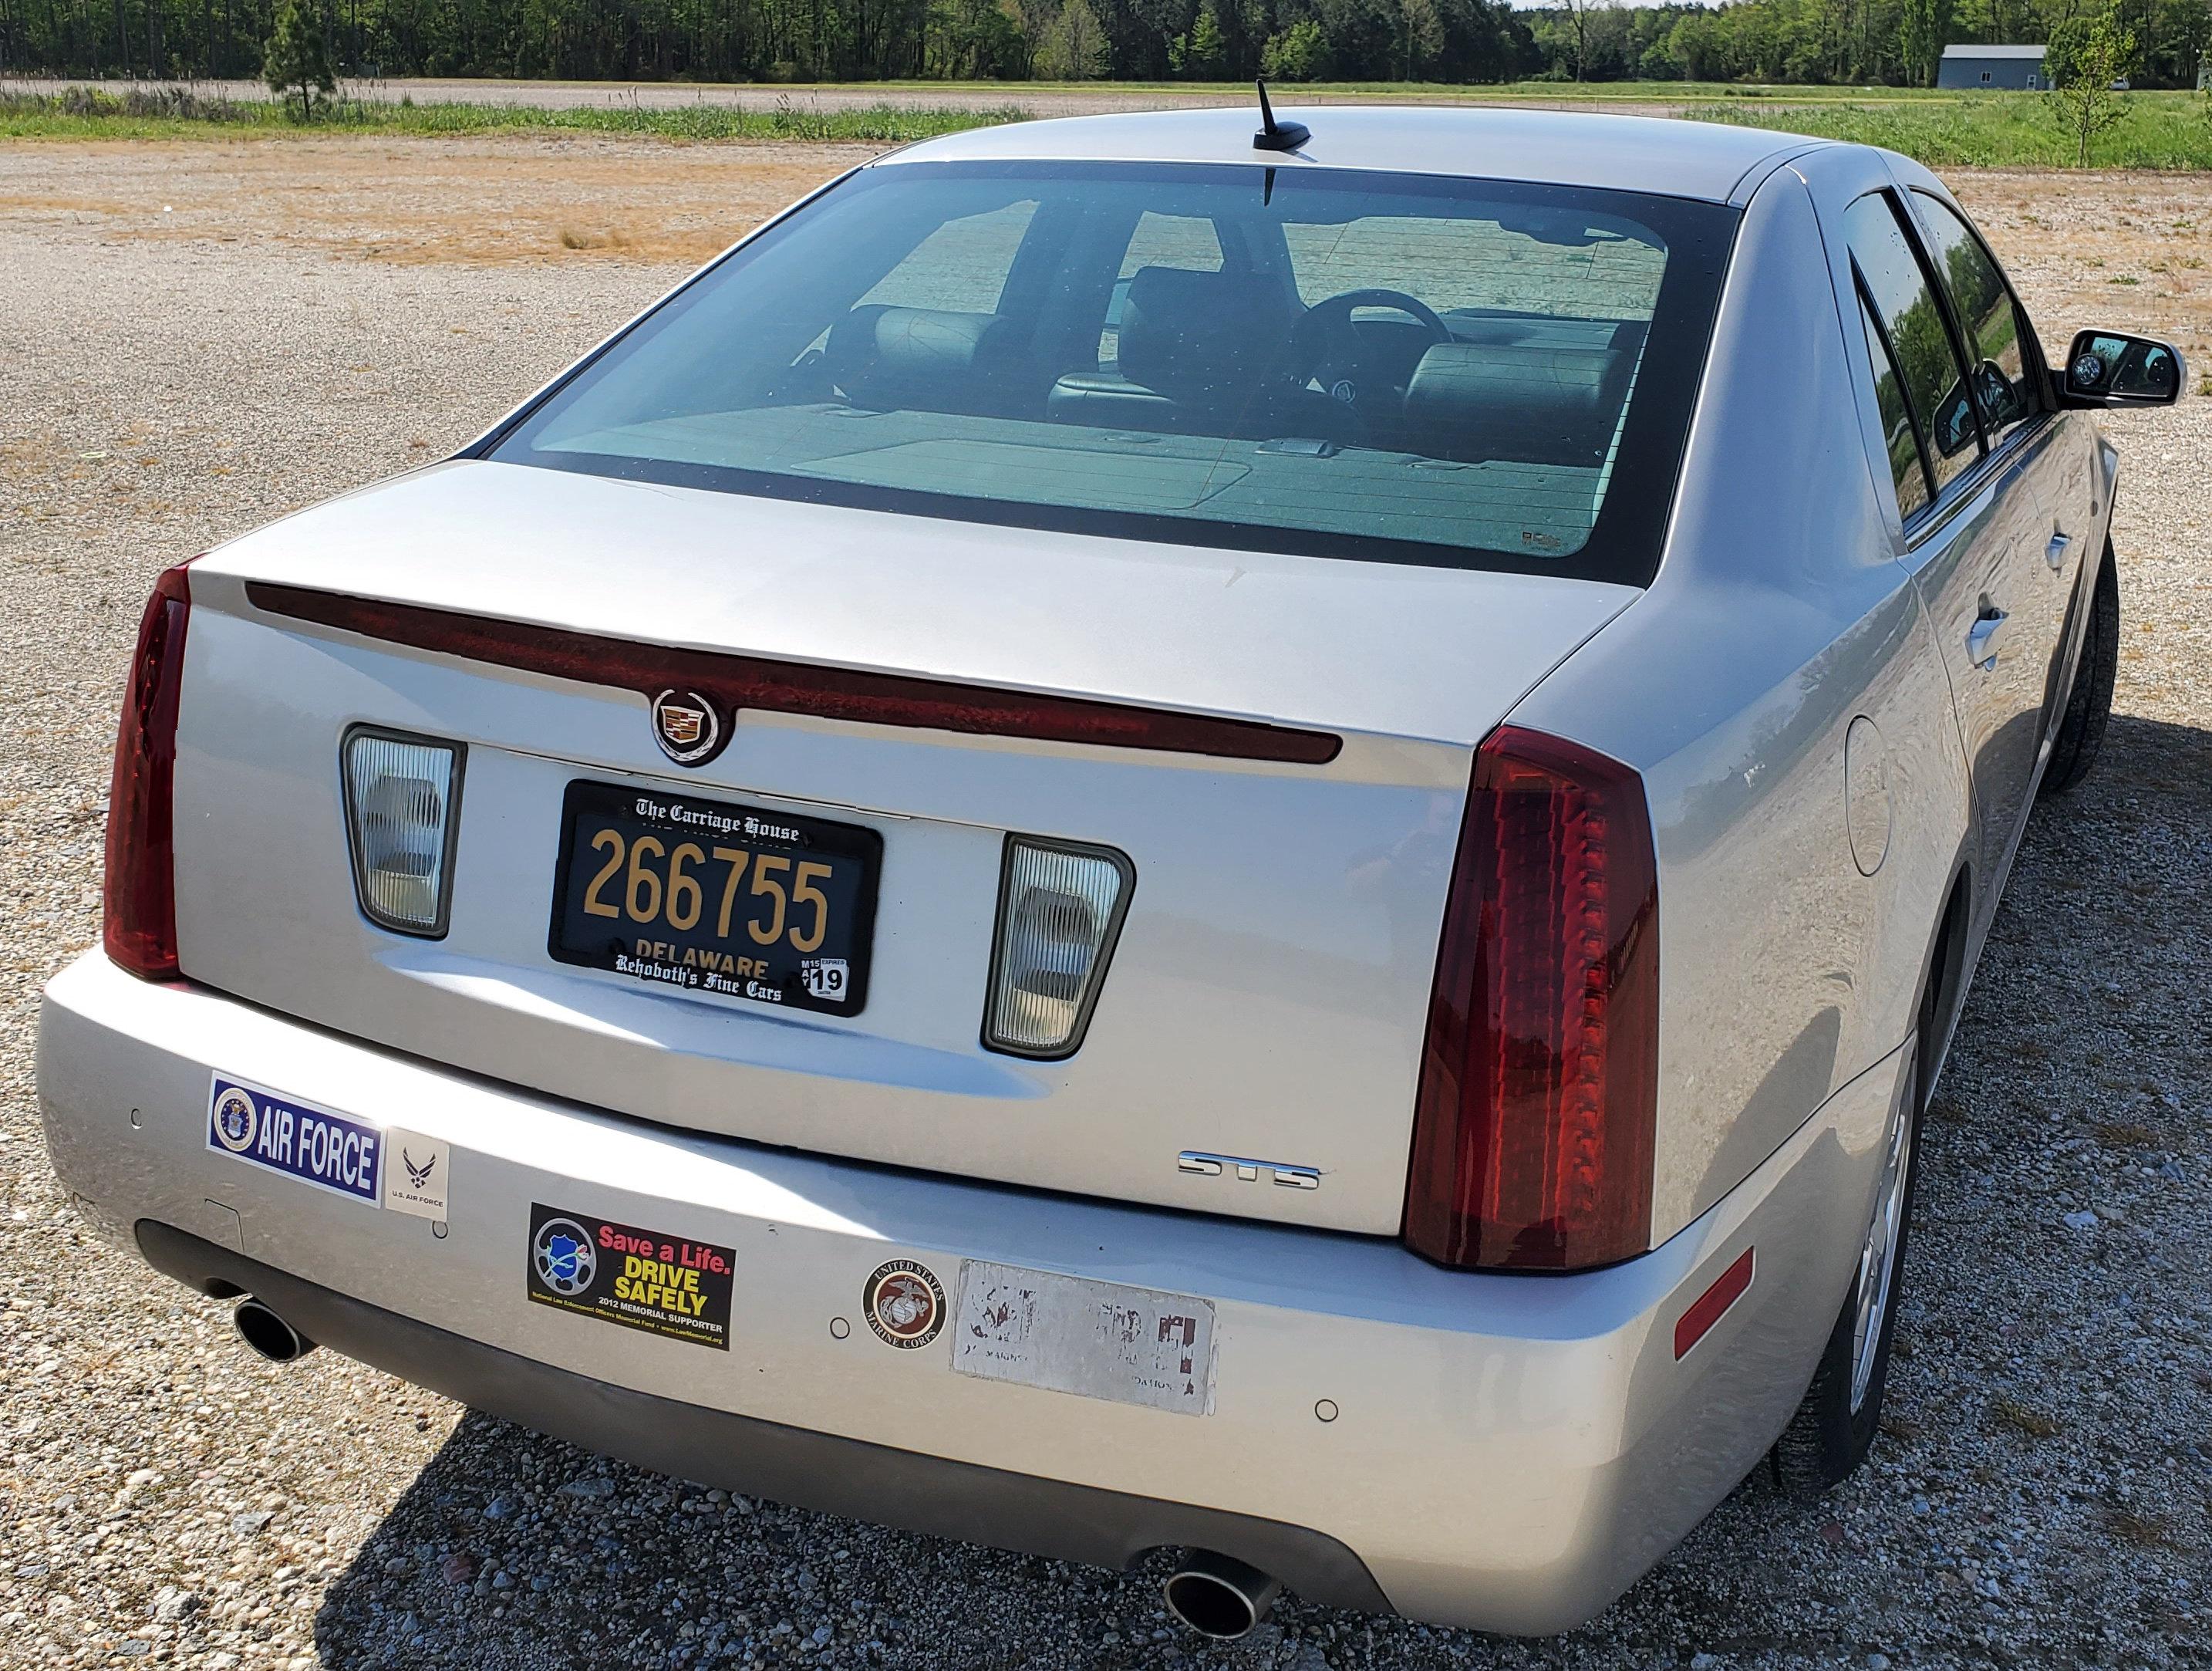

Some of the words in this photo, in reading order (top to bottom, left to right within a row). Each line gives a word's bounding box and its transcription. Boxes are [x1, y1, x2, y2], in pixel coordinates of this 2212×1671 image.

[636, 798, 666, 820] The
[670, 805, 741, 832] Carriage
[744, 816, 800, 841] House
[584, 829, 832, 953] 266755
[615, 954, 697, 987] Rehoboth's
[703, 971, 740, 994] Fine
[746, 981, 782, 1001] Cars
[636, 939, 769, 980] DELAWARE
[812, 969, 843, 991] 19
[258, 1106, 293, 1165] AIR
[298, 1117, 374, 1190] FORCE
[1178, 1150, 1319, 1190] STS
[392, 1190, 404, 1199] U.S.
[420, 1197, 443, 1207] FORCE
[599, 1225, 653, 1257] Save
[659, 1244, 674, 1262] a
[680, 1244, 731, 1274] Life.
[625, 1255, 700, 1293] DRIVE
[875, 1261, 914, 1280] UNITED
[915, 1265, 945, 1301] STATES
[598, 1296, 619, 1308] 2012
[620, 1301, 667, 1320] MEMORIAL
[668, 1313, 723, 1333] SUPPORTER
[615, 1276, 708, 1316] SAFELY
[866, 1311, 900, 1346] MARINE
[903, 1328, 937, 1349] CORPS
